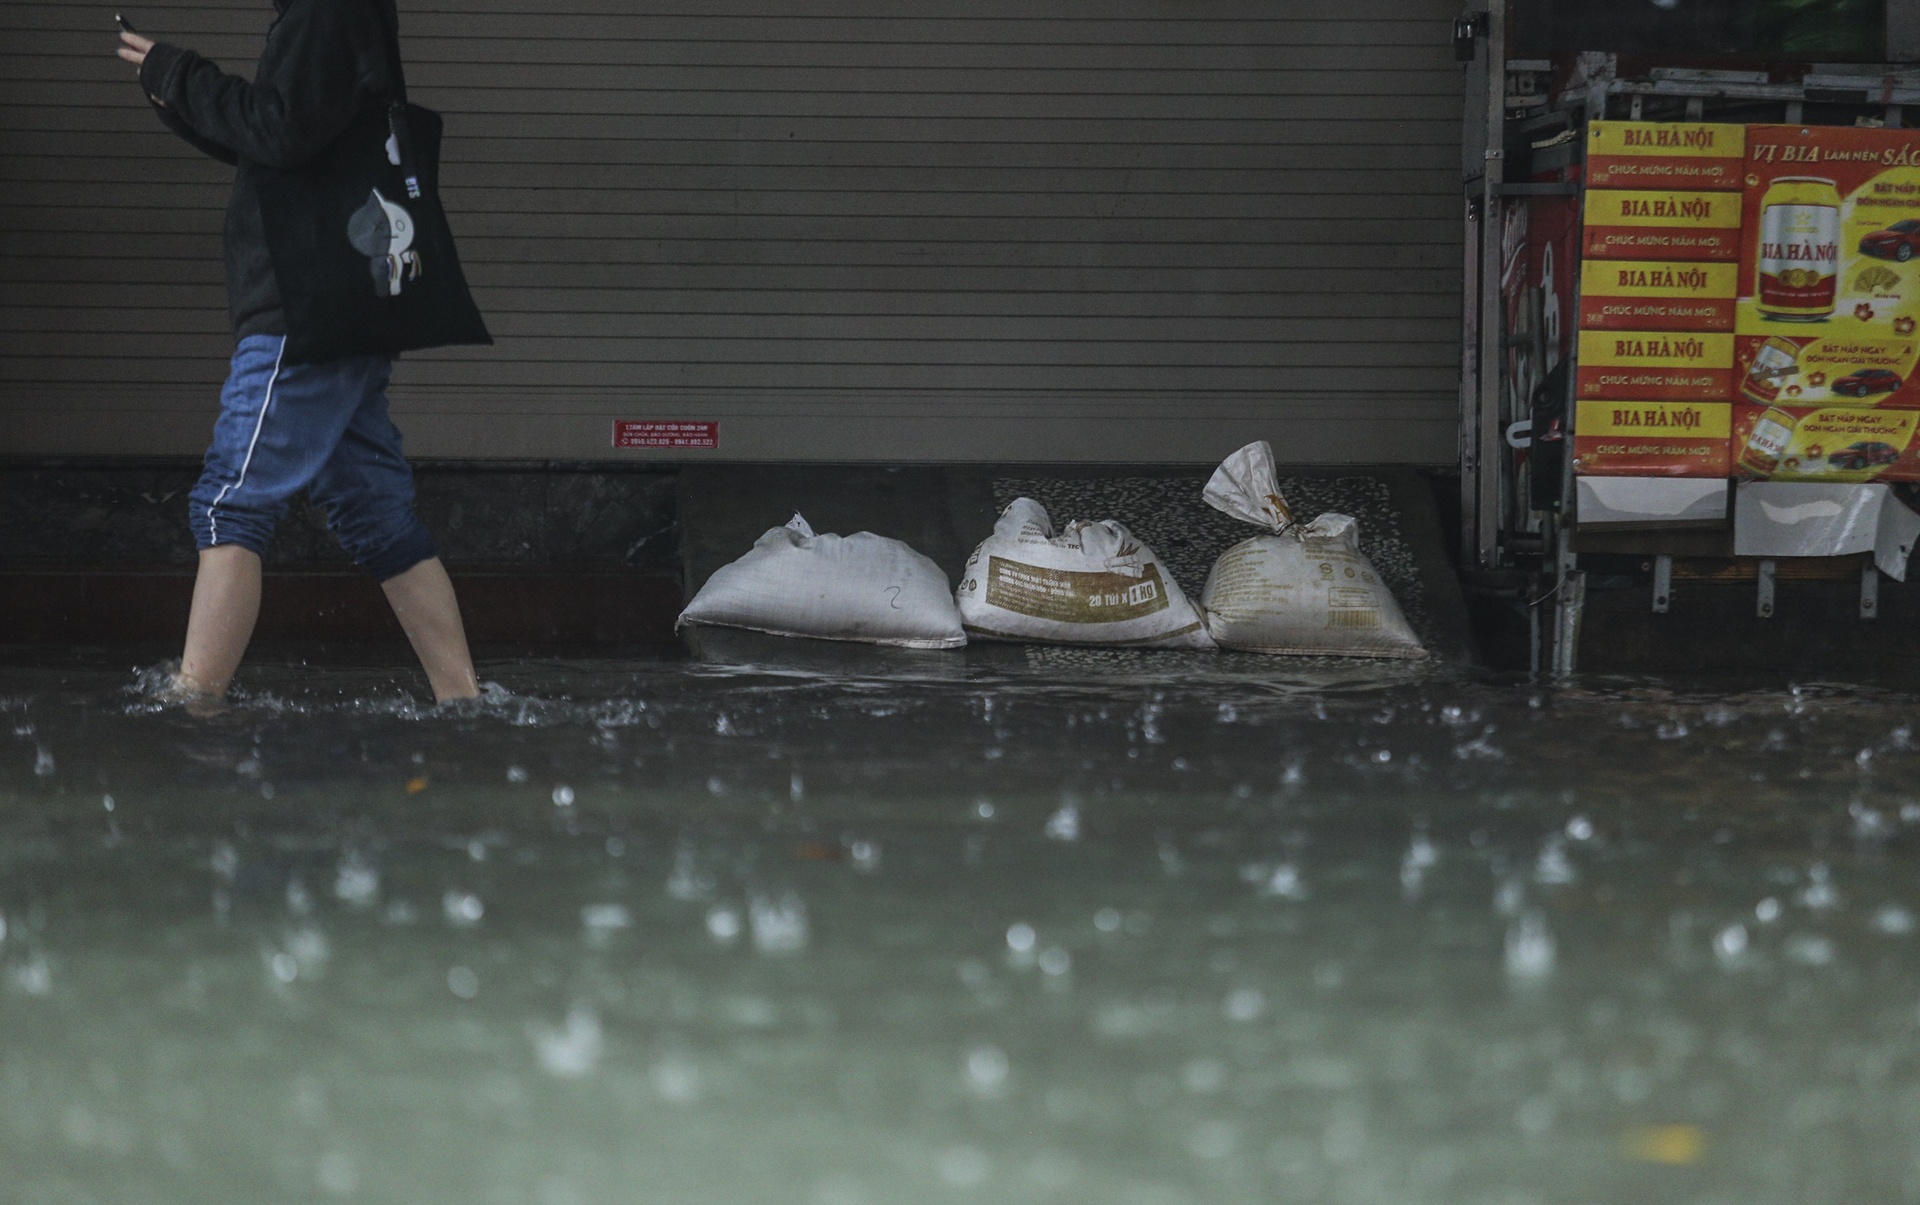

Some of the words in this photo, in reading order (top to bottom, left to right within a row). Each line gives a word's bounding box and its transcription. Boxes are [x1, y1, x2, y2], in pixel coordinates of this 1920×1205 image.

[1624, 129, 1653, 146] BIA
[1656, 126, 1680, 147] HÀ
[1684, 127, 1714, 151] NỘI
[1753, 144, 1777, 163] VỊ
[1781, 145, 1820, 162] BIA
[405, 177, 420, 199] BTS
[1621, 200, 1649, 217] BIA
[1653, 196, 1677, 217] HÀ
[1681, 197, 1711, 221] NỘI
[1786, 240, 1812, 261] HÀ
[1618, 270, 1646, 287] BIA
[1650, 266, 1674, 287] HÀ
[1678, 268, 1707, 291] NỘI
[1615, 340, 1644, 357] BIA
[1647, 336, 1670, 357] HÀ
[1674, 337, 1704, 361] NỘI
[1612, 410, 1641, 426] BIA
[1644, 406, 1667, 427] HÀ
[1671, 407, 1701, 431] NỘI
[1089, 594, 1102, 607] 20
[1132, 588, 1137, 602] 1
